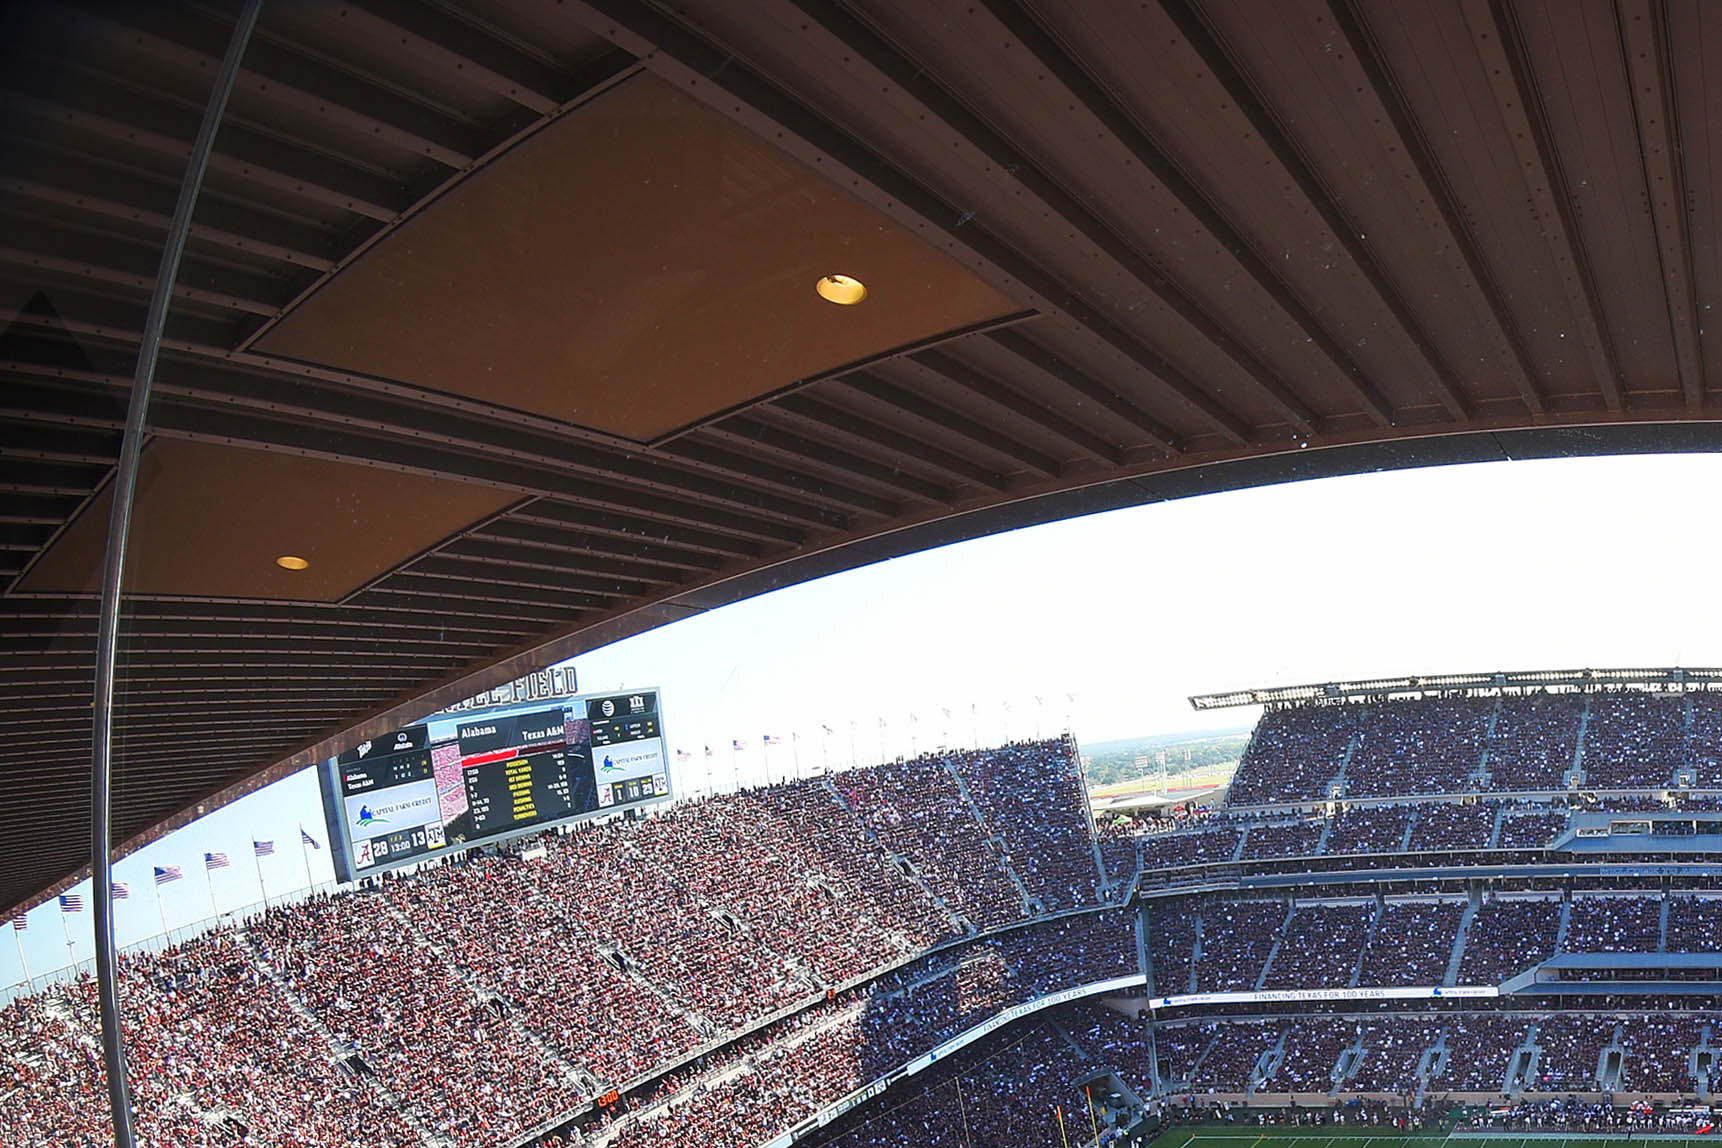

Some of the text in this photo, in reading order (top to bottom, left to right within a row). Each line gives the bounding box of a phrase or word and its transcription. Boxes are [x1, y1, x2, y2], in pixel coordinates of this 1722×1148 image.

[511, 667, 577, 702] FIELD
[462, 726, 496, 739] Alabama
[522, 725, 564, 741] Texas A&M
[629, 786, 639, 797] 10
[411, 831, 426, 847] 13
[373, 841, 411, 857] 28 13:00
[1011, 1005, 1031, 1018] TEXAS
[1063, 988, 1086, 1000] YEARS
